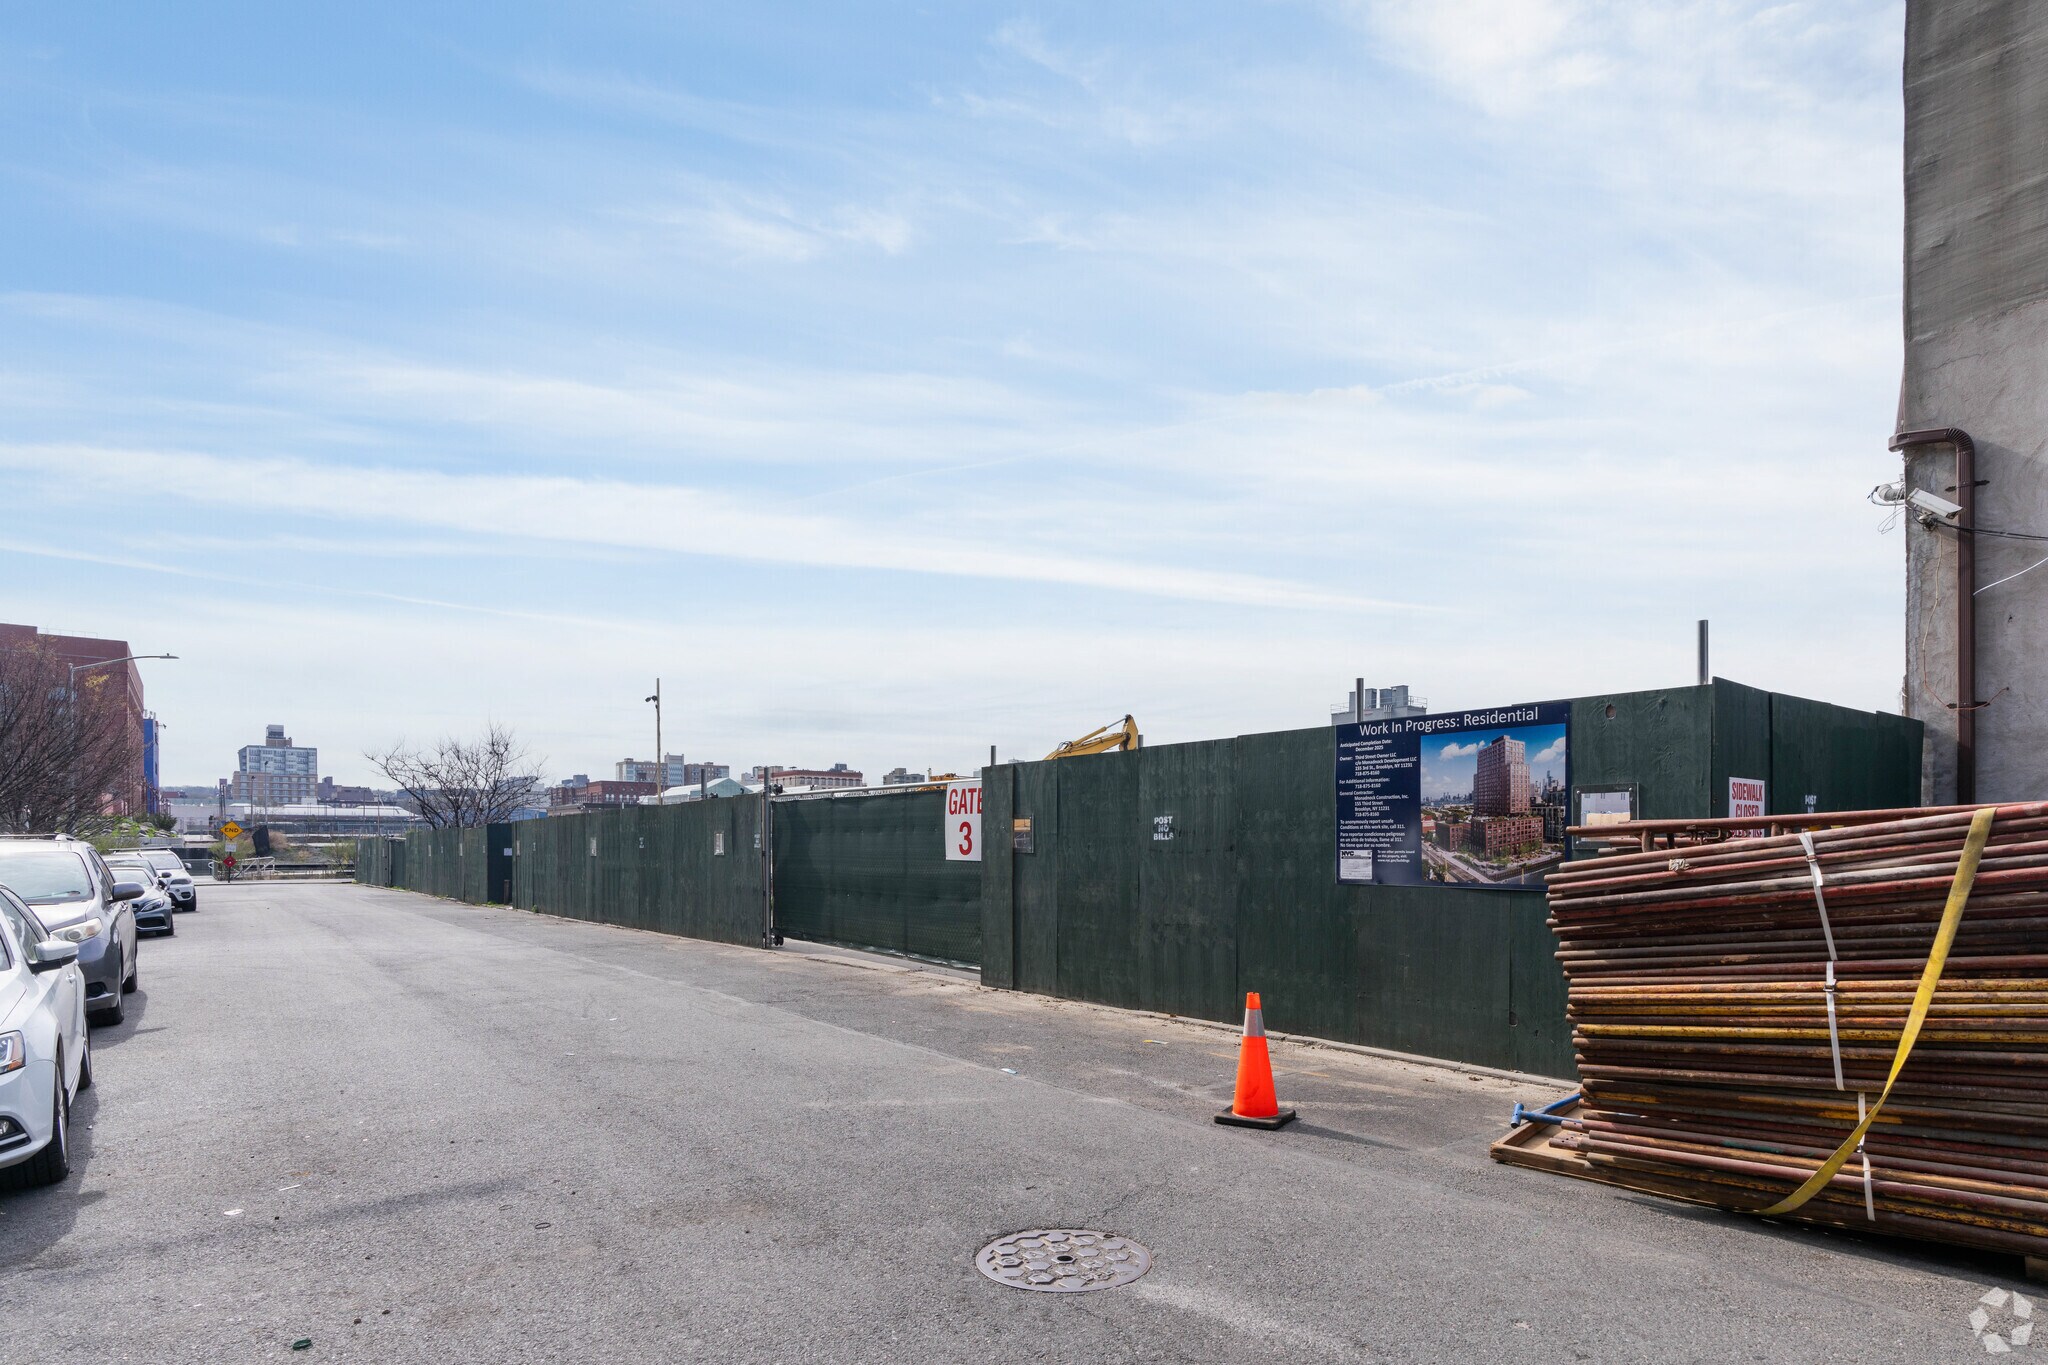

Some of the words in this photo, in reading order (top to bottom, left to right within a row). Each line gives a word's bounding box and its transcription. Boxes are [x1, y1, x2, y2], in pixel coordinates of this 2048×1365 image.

[1359, 722, 1389, 736] Work
[1392, 721, 1402, 734] In
[1406, 716, 1460, 732] Progress:
[1464, 706, 1539, 726] Residential
[1732, 782, 1763, 802] SIDEWALK
[1805, 794, 1816, 805] POST
[1736, 803, 1760, 817] CLOSED
[1154, 816, 1173, 824] POST
[1158, 824, 1169, 832] NO
[958, 821, 972, 856] 3
[1153, 832, 1174, 841] BILLS
